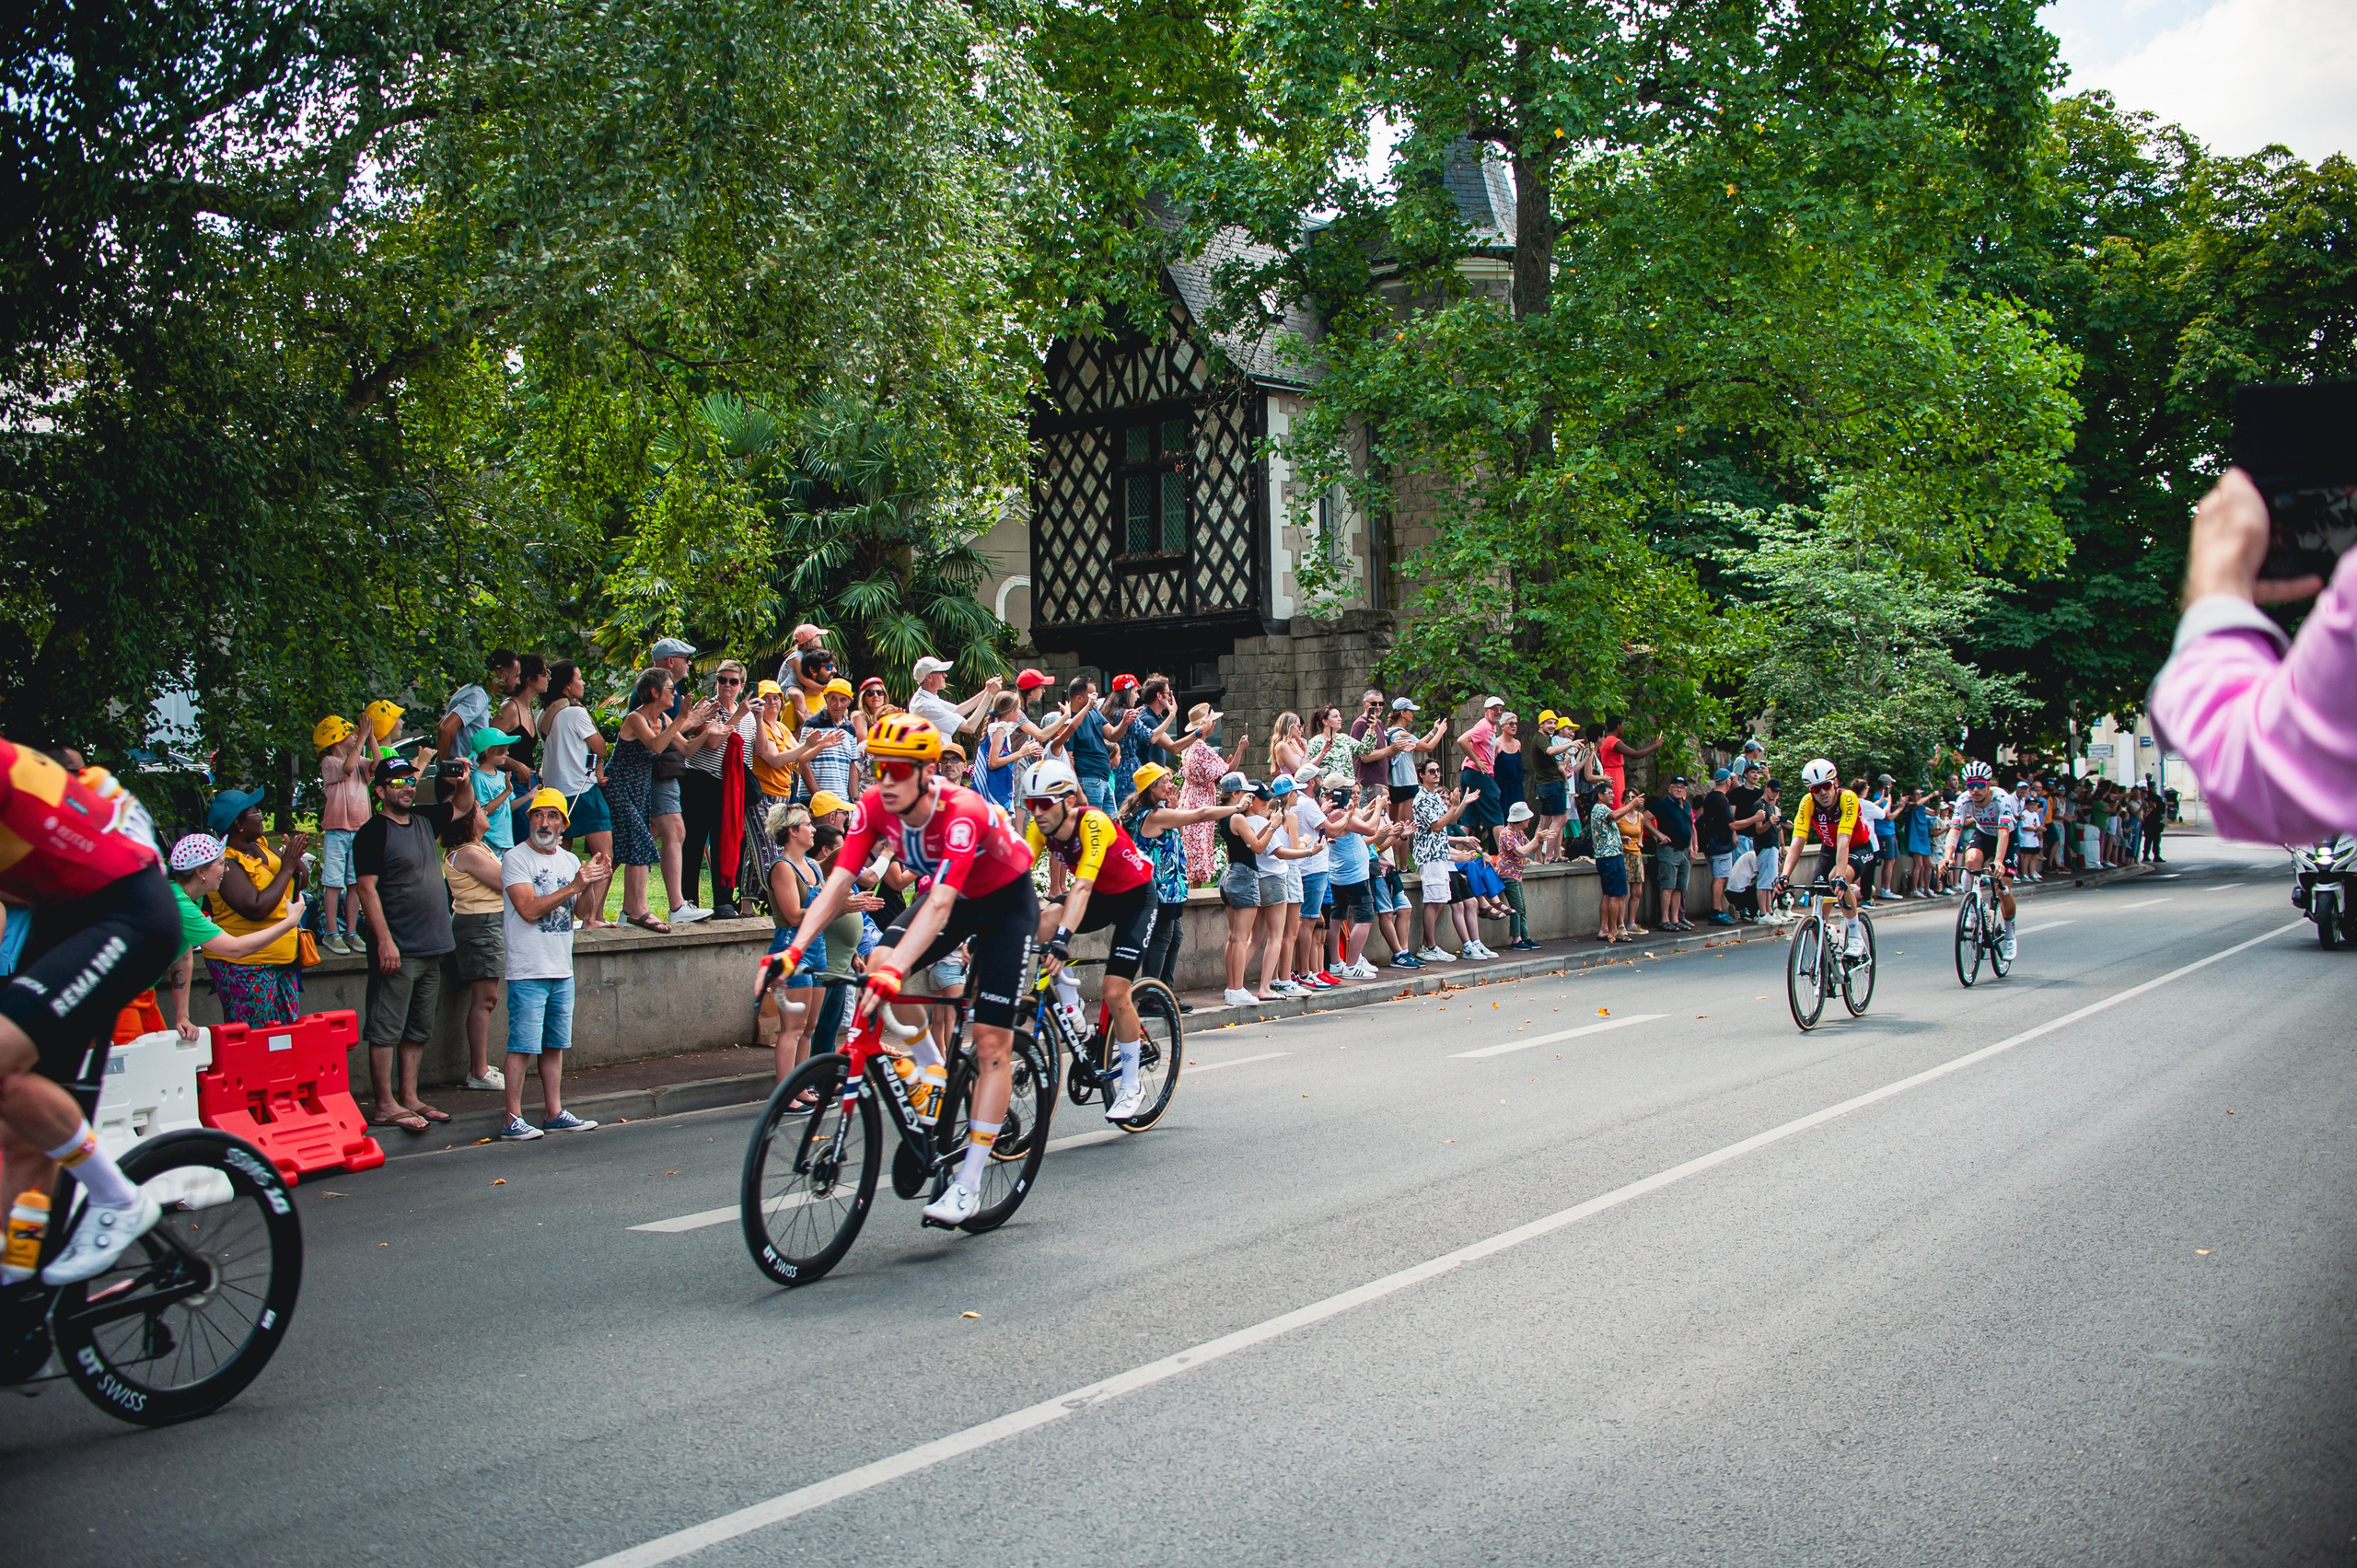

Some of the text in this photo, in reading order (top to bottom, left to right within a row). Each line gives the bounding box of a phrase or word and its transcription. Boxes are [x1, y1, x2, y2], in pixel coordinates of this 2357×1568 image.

[50, 936, 127, 1017] REMA 1000
[981, 992, 1011, 1005] FUSION
[1052, 1002, 1088, 1063] LOOK
[877, 1054, 924, 1133] RIDLEY
[763, 1243, 798, 1278] DT SWISS
[76, 1345, 147, 1412] DT SWISS
